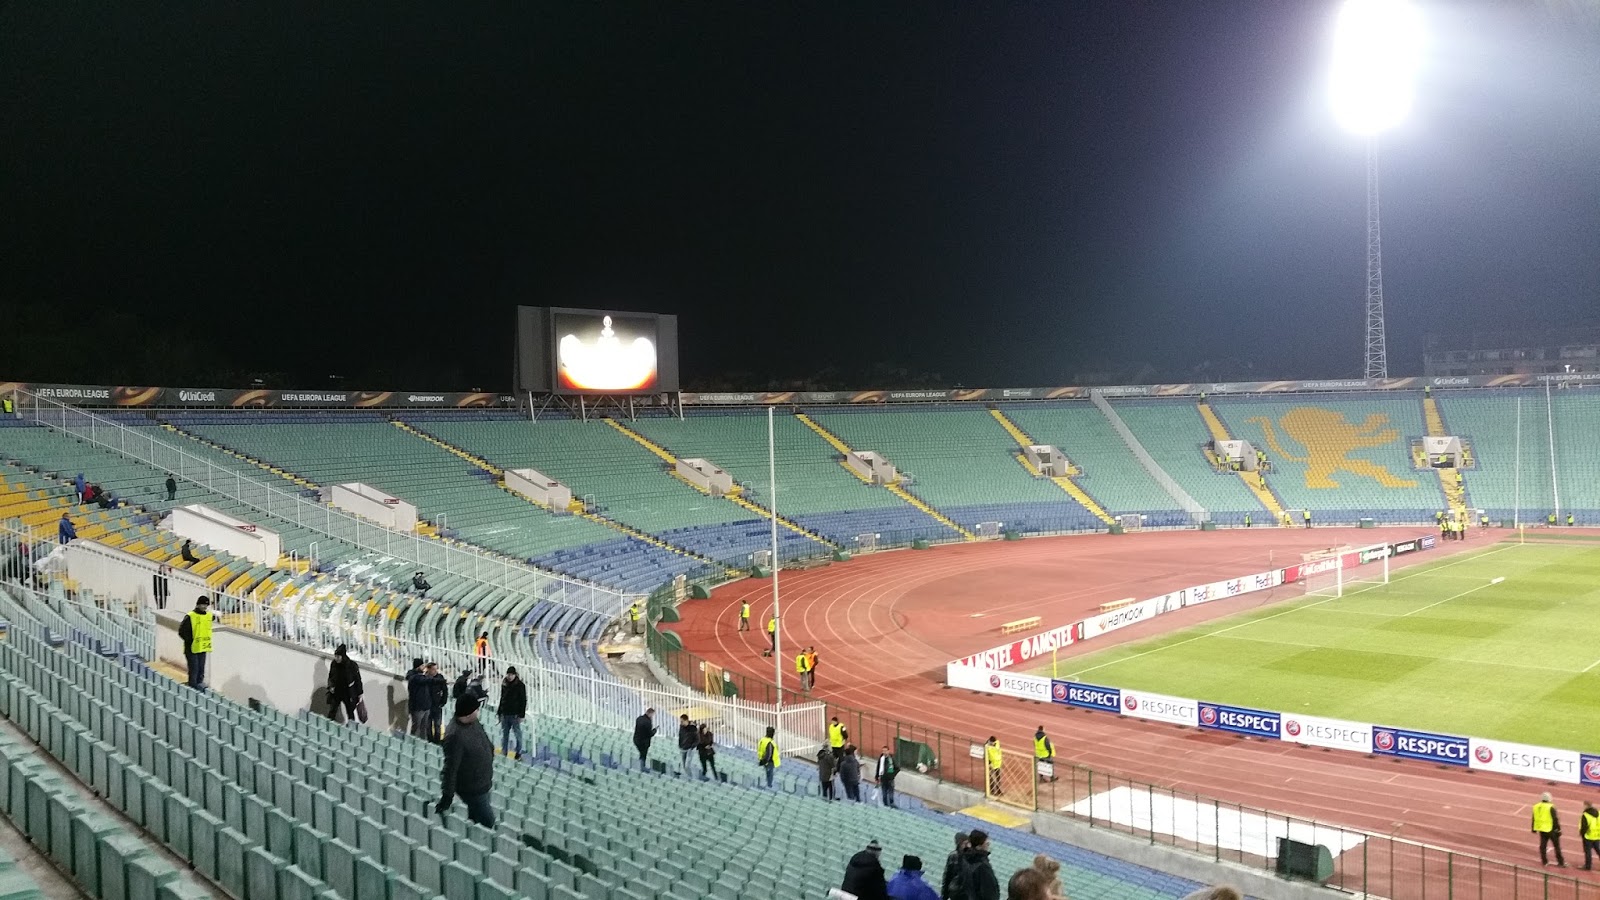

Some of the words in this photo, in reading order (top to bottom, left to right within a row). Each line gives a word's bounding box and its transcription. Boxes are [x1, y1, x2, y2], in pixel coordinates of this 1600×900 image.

[36, 388, 56, 397] UEFA
[56, 388, 82, 398] EUROPA
[83, 390, 110, 398] LEAGUE
[187, 391, 216, 402] UniCredit
[281, 393, 299, 401] UEFA
[299, 394, 323, 402] EUROPA
[323, 394, 346, 402] LEAGUE
[1194, 586, 1216, 602] FedEx
[1227, 580, 1246, 595] FedEx
[1030, 625, 1074, 658] AMSTEL
[966, 643, 1013, 670] AMSTEL
[1004, 678, 1050, 696] RESPECT
[1069, 689, 1119, 707] RESPECT
[1141, 700, 1196, 720] RESPECT
[1220, 711, 1280, 732] RESPECT
[1306, 724, 1369, 744] RESPECT
[1398, 736, 1468, 760] RESPECT
[1500, 751, 1576, 774] RESPECT
